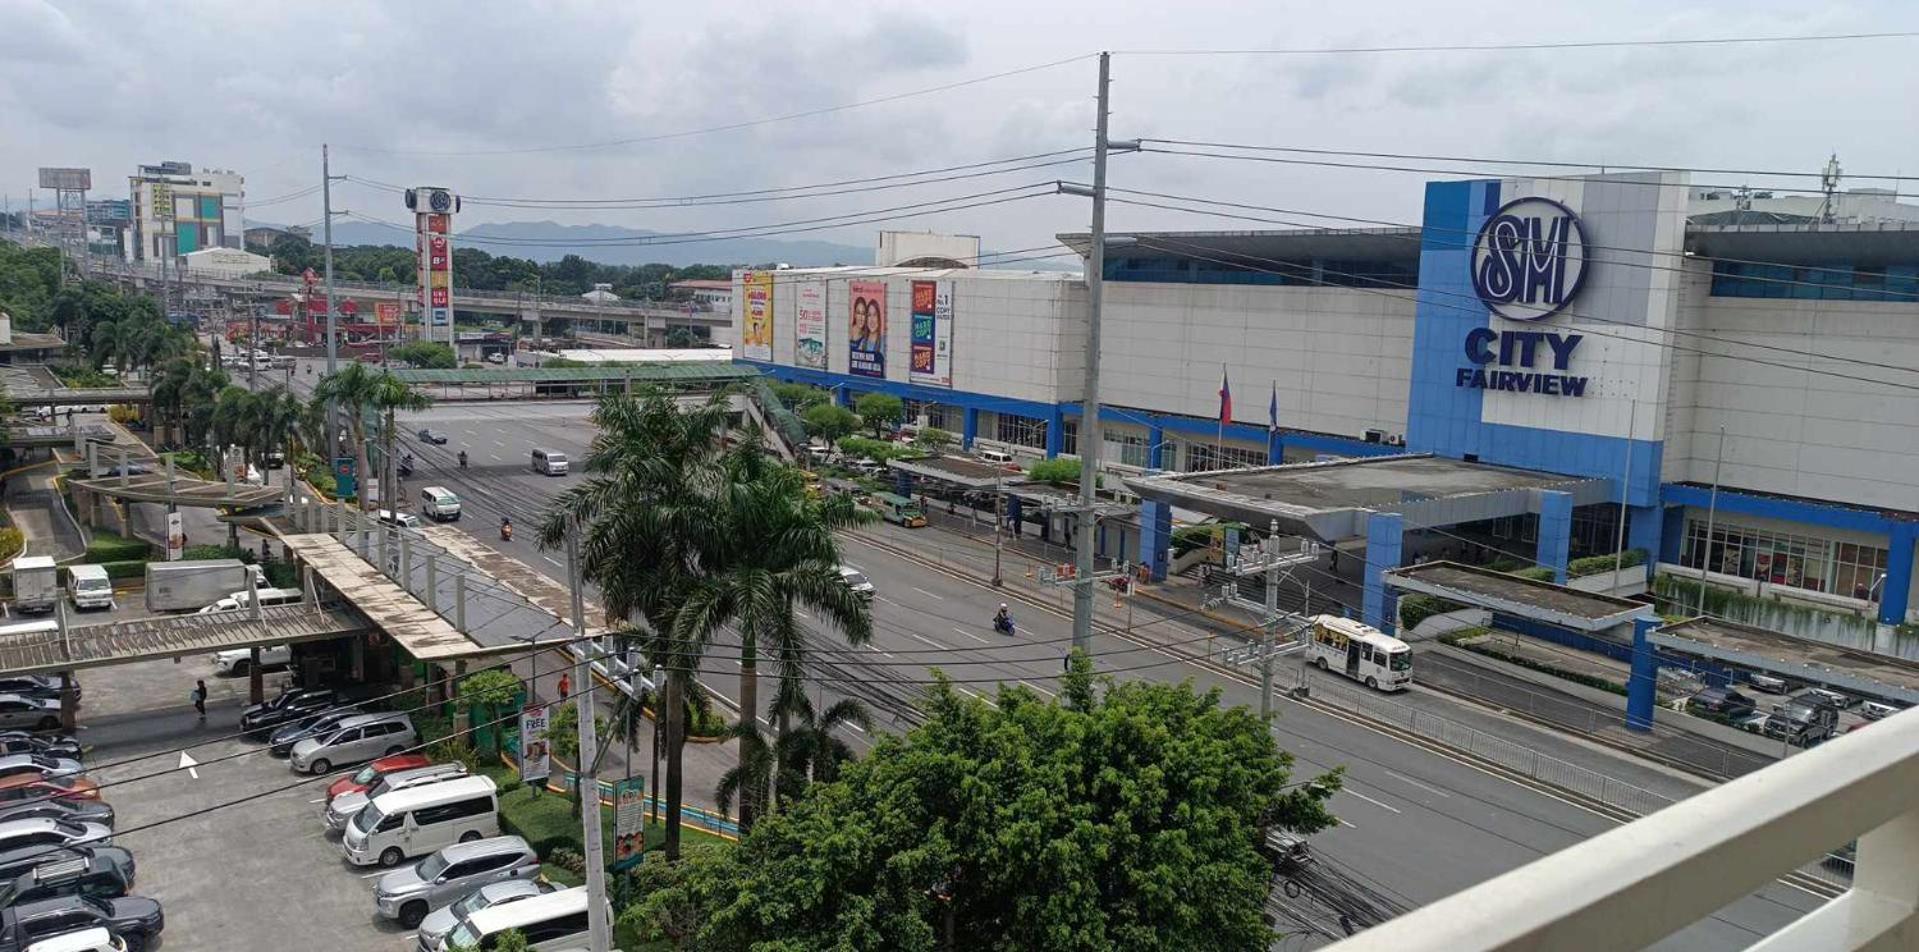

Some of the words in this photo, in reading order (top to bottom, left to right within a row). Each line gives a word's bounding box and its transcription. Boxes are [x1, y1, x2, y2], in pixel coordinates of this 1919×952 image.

[1479, 214, 1571, 305] SM
[1465, 327, 1583, 370] CITY
[1456, 368, 1588, 397] FAIRVIEW
[526, 718, 546, 730] FREE
